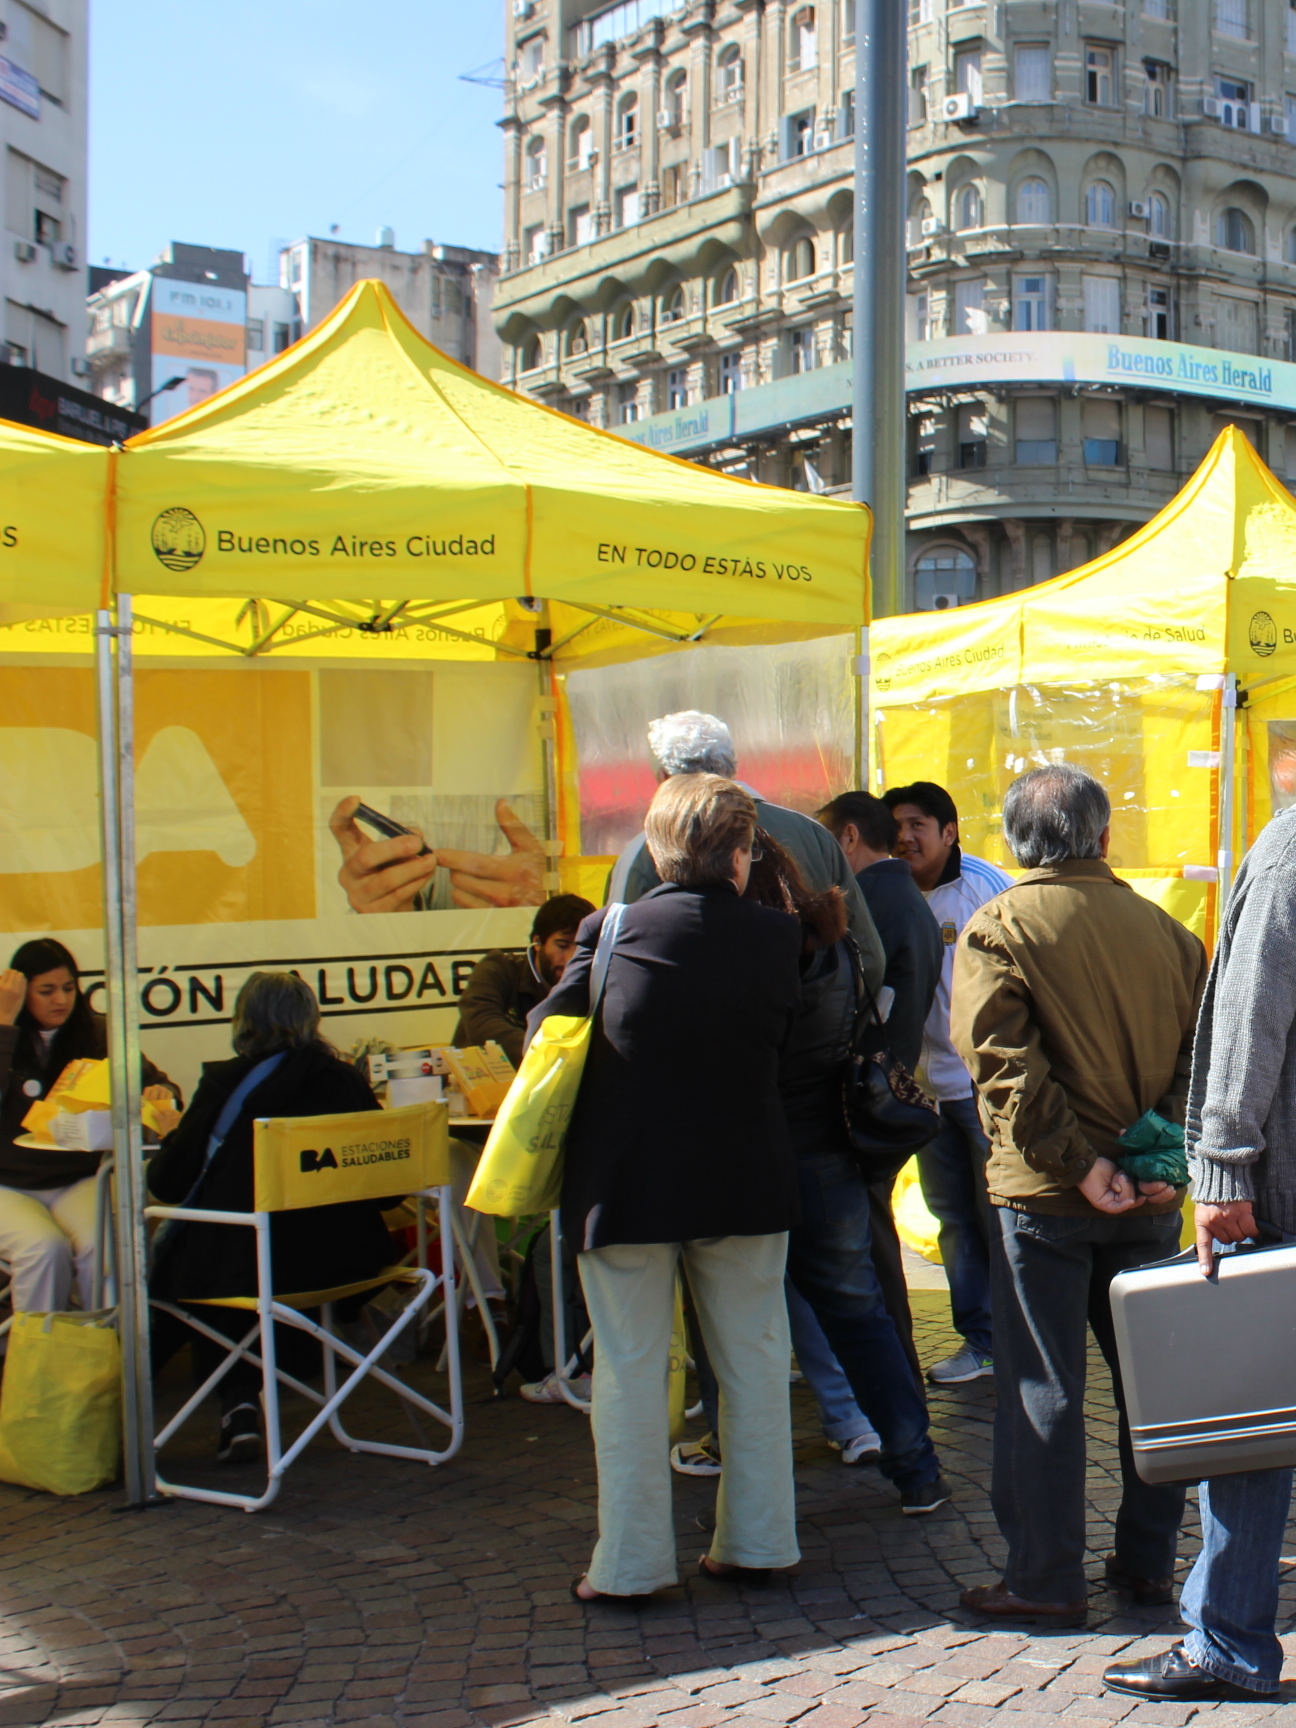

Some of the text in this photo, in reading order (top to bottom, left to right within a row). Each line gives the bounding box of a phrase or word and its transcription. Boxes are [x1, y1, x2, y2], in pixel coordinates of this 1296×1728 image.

[926, 355, 973, 368] BETTER
[1106, 343, 1272, 392] Buenos Aires Herald
[648, 422, 673, 447] Aires
[674, 409, 709, 440] Herald
[217, 530, 496, 557] Buenos Aires Ciudad
[597, 543, 812, 582] EN TODO ESTÁS VOS
[1165, 624, 1206, 643] Salud
[934, 654, 962, 670] Aires
[964, 644, 1005, 664] Ciudad
[300, 1147, 338, 1173] BA
[341, 1138, 411, 1157] ESTACIONES
[341, 1148, 410, 1168] SALUDABLES
